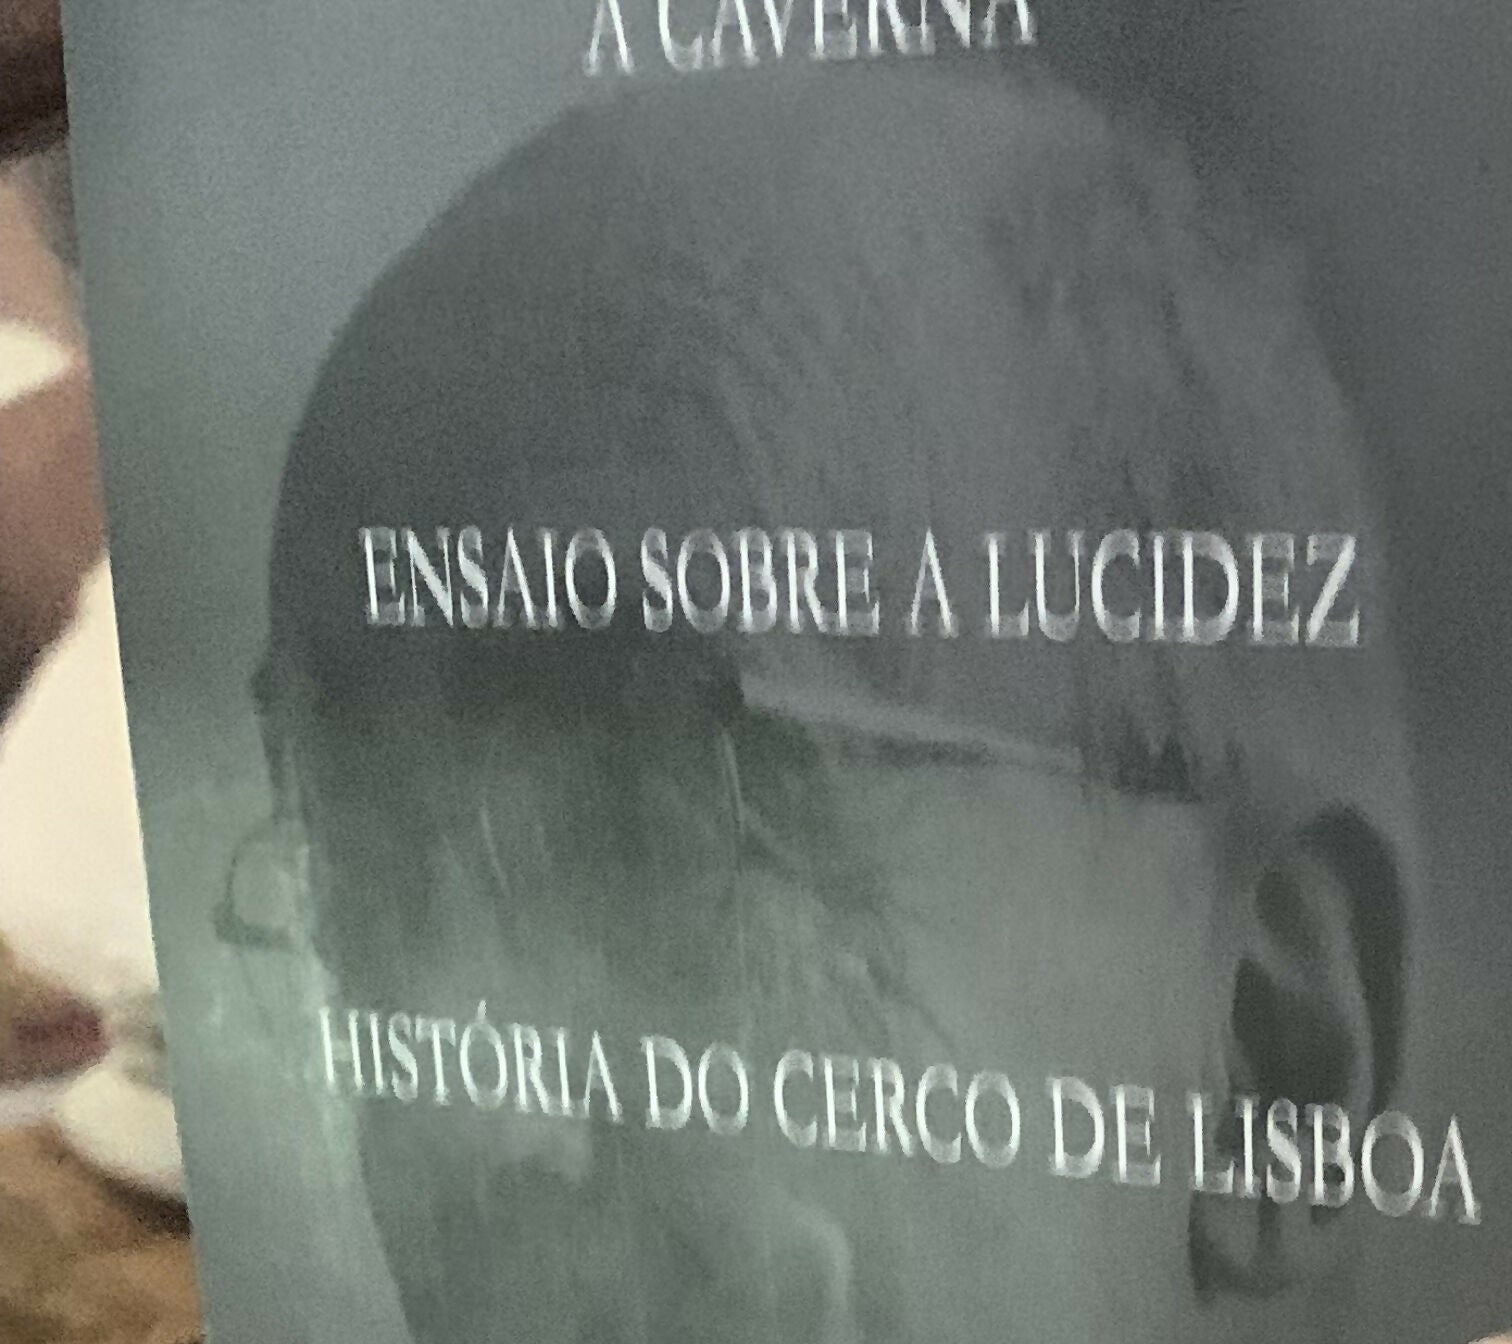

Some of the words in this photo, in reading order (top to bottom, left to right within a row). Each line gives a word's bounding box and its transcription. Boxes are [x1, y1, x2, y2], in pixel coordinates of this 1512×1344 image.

[358, 526, 619, 631] ENSAIO
[642, 526, 881, 637] SOBRE
[907, 528, 958, 639] A
[984, 529, 1361, 648] LUCIDEZ
[316, 1000, 623, 1130] HISTÓRIA
[640, 1032, 750, 1138] DO
[772, 1047, 1021, 1169] CERCO
[1049, 1075, 1164, 1190] DE
[1187, 1091, 1483, 1227] LISBOA
